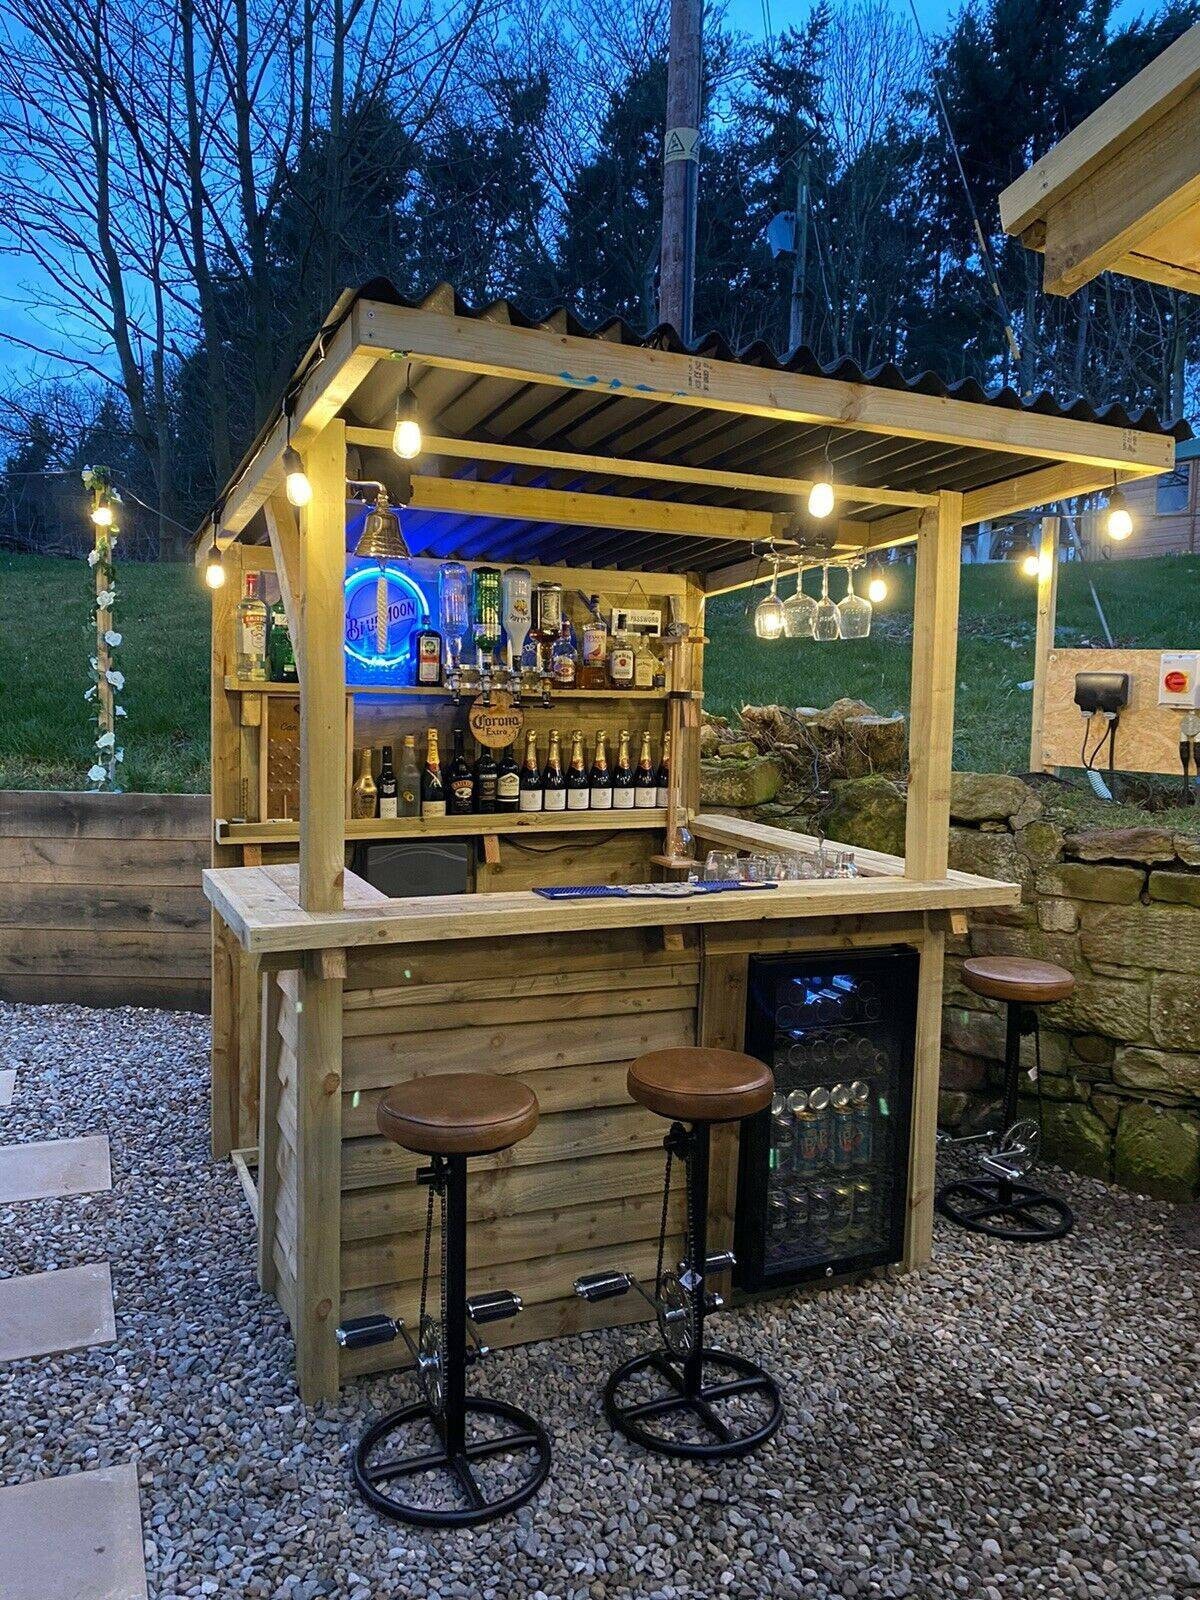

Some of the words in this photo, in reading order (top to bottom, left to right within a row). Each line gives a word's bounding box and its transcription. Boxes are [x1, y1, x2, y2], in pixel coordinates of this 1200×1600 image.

[629, 615, 659, 623] PASSWORD
[472, 714, 519, 731] Corona
[486, 728, 507, 736] Extra
